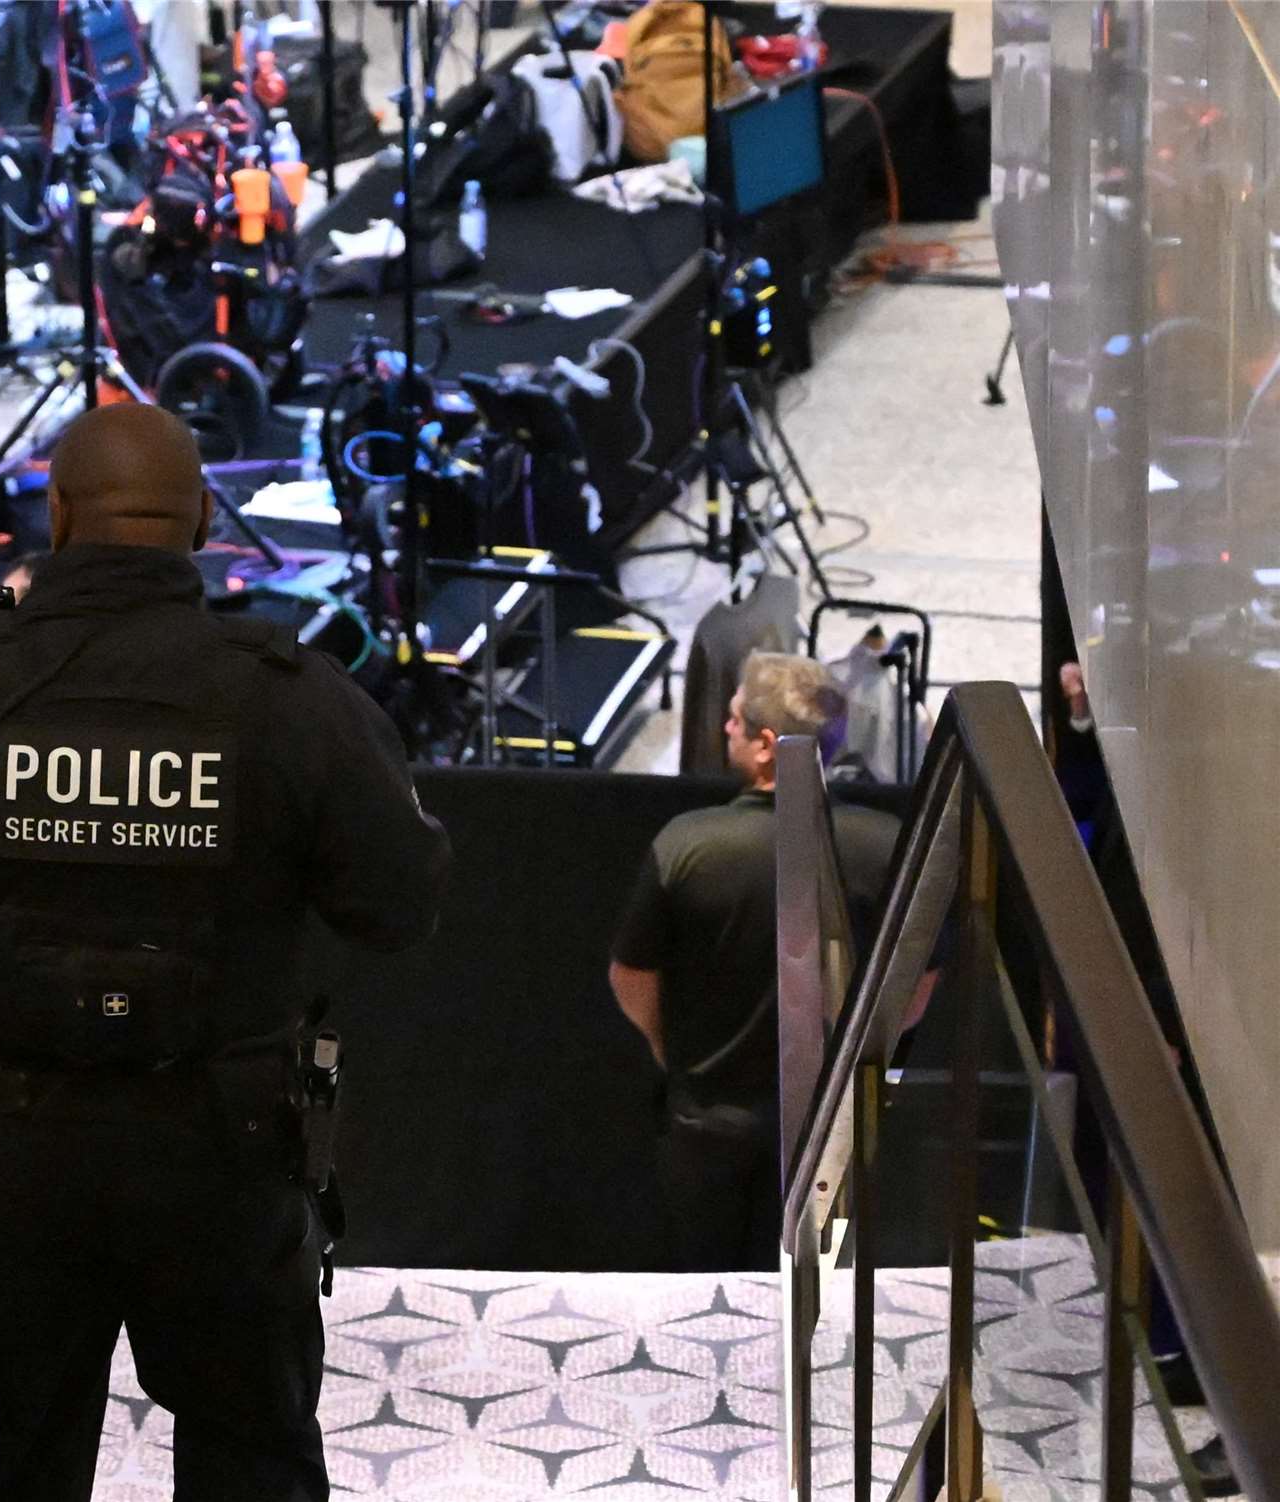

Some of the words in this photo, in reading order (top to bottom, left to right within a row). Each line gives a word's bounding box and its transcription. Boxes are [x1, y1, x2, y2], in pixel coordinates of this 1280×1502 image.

[5, 744, 222, 809] POLICE
[5, 816, 102, 845] SECRET
[111, 822, 219, 848] SERVICE
